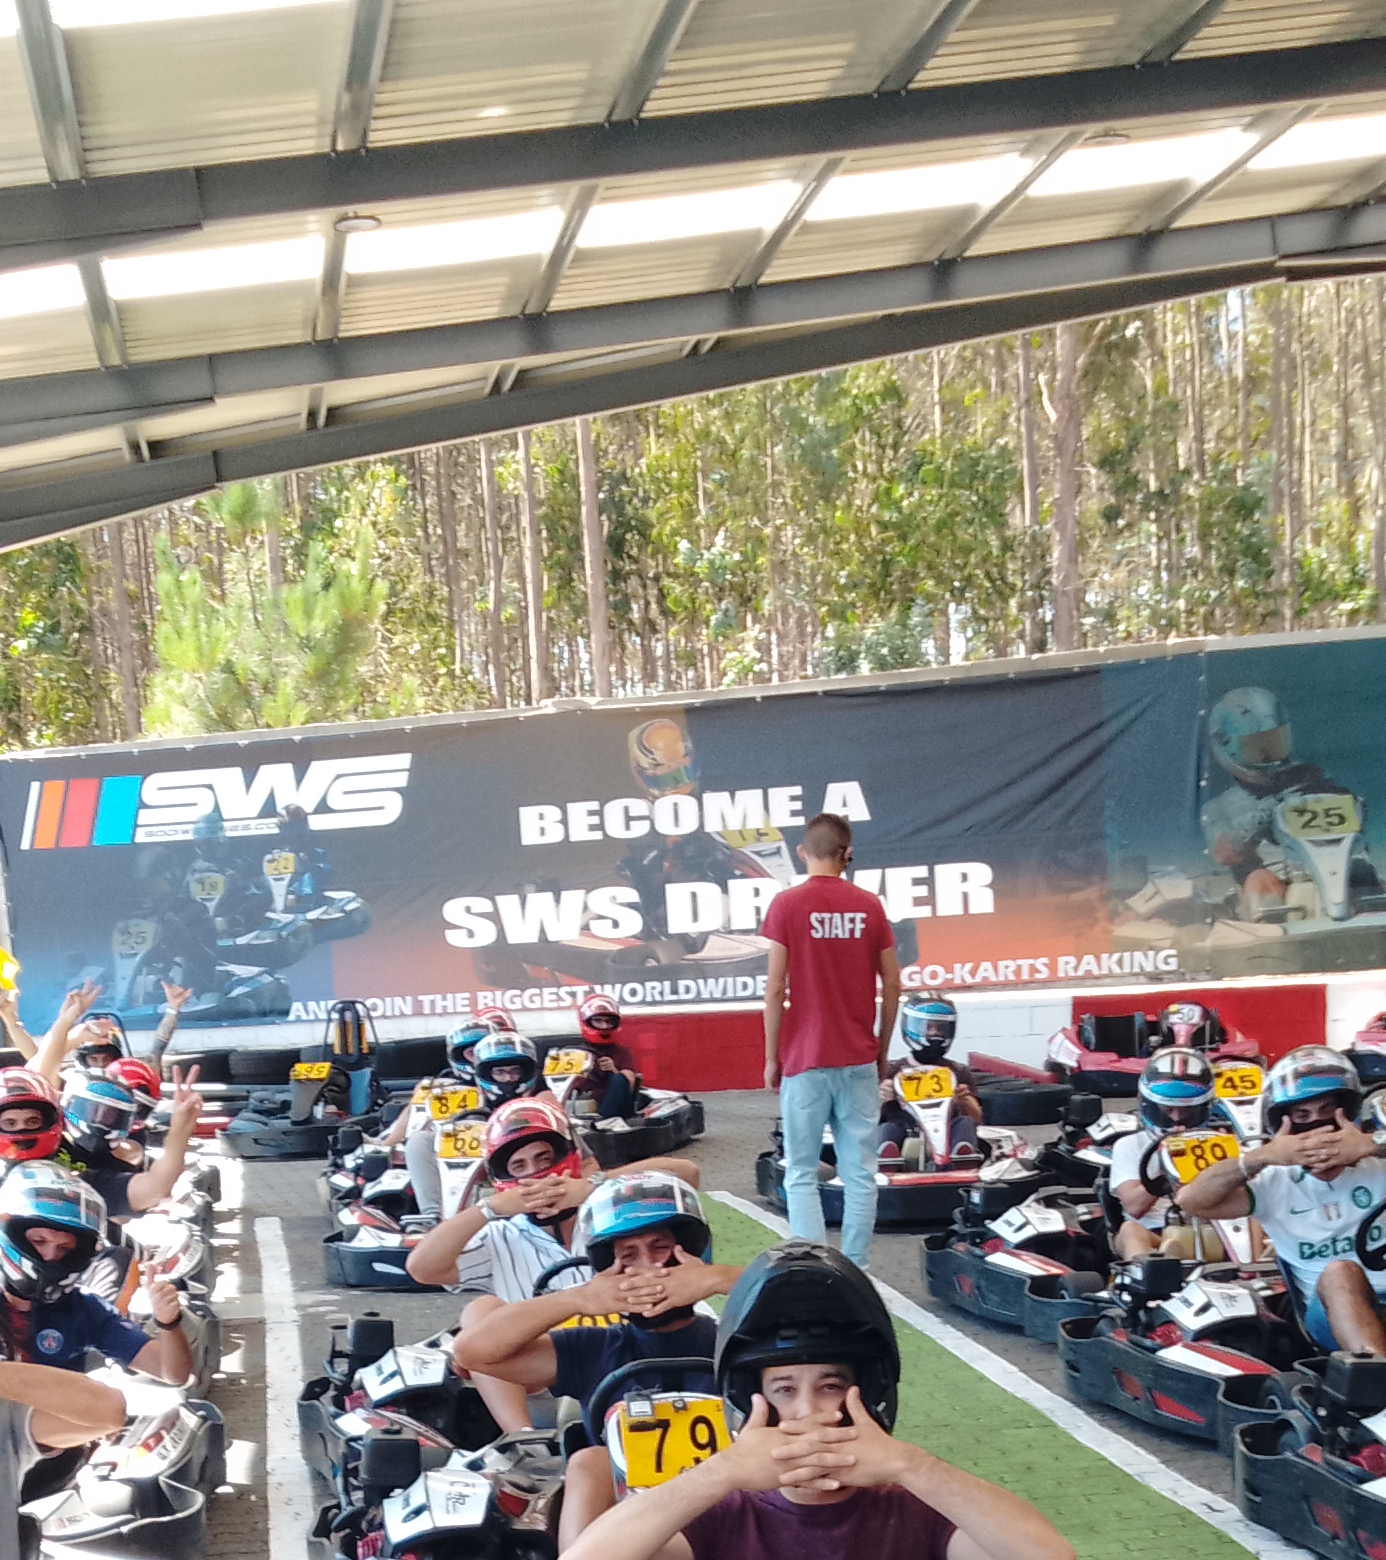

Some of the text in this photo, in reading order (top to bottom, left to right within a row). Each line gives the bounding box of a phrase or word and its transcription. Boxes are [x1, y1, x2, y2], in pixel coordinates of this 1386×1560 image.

[139, 752, 413, 830] SWS
[518, 780, 871, 847] BECOME A
[1298, 807, 1346, 831] 25
[442, 861, 995, 949] SWS DRVER
[810, 912, 868, 940] STAFF
[358, 995, 412, 1017] OIN
[420, 990, 471, 1014] THE
[480, 983, 589, 1010] BIGGEST
[595, 974, 769, 1003] WORLDWIDE
[900, 957, 1050, 987] GO-KARTS
[1056, 949, 1179, 978] RAKING
[913, 1072, 945, 1098] 73
[1221, 1072, 1258, 1092] 45
[438, 1094, 469, 1115] 84
[1189, 1142, 1229, 1172] 89
[1298, 1223, 1383, 1260] Betao
[629, 1414, 719, 1473] 79
